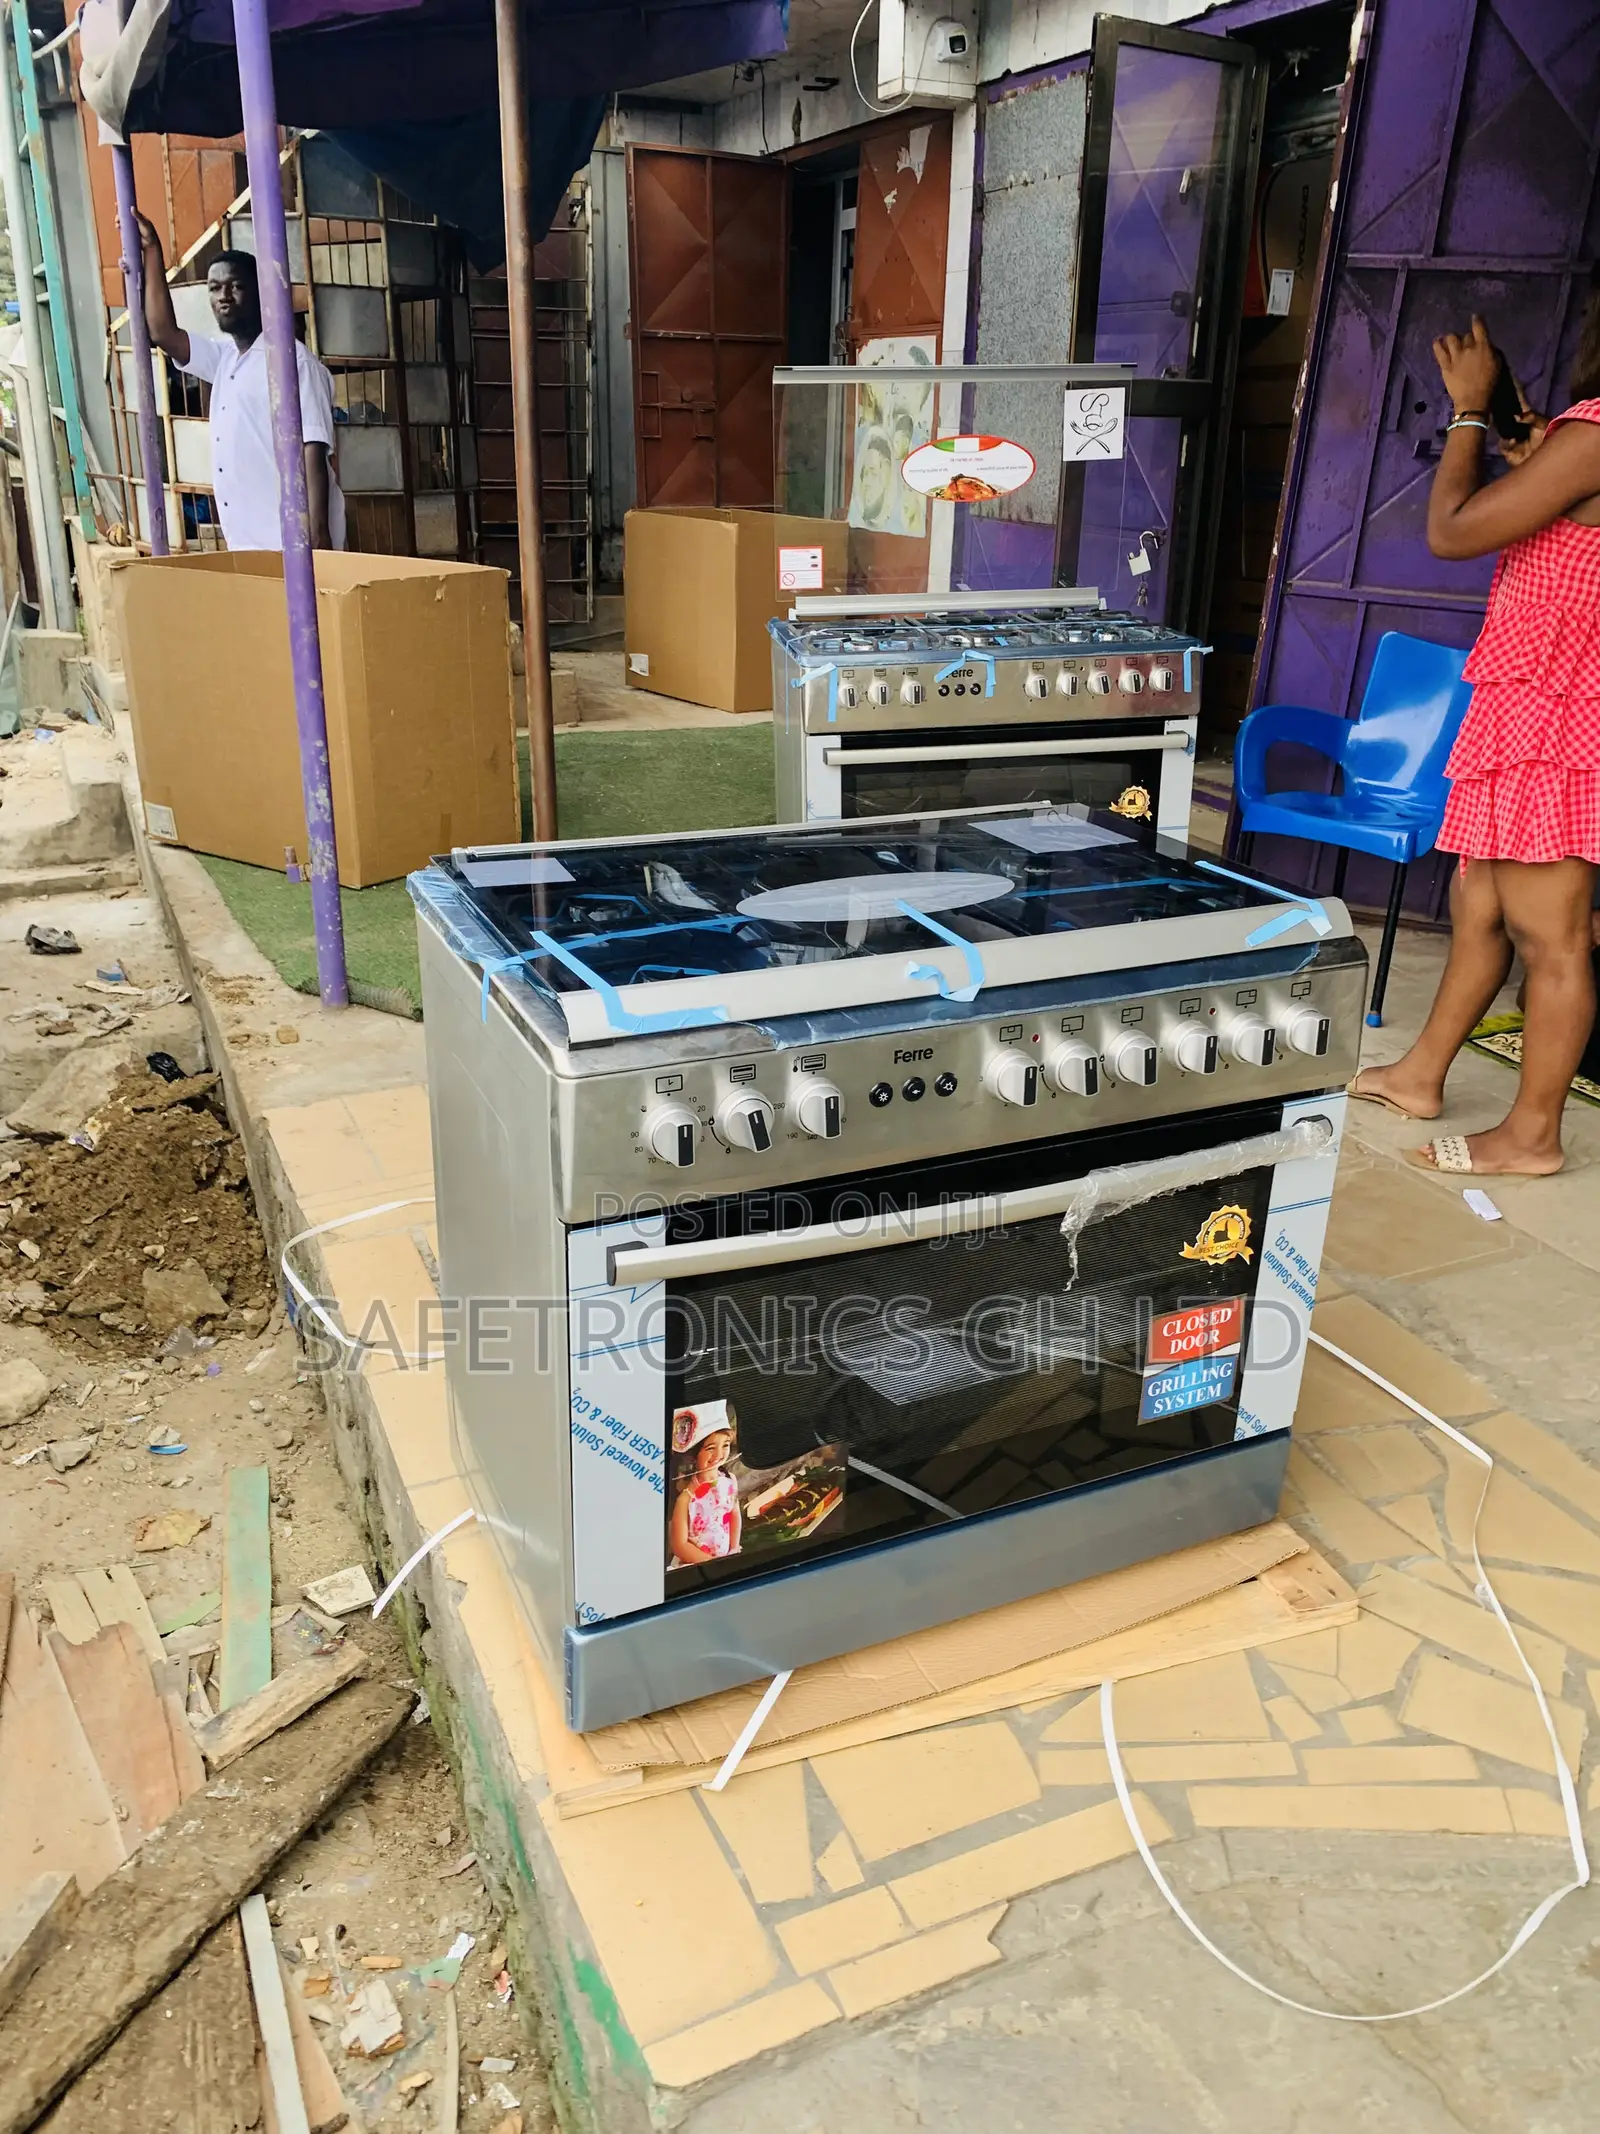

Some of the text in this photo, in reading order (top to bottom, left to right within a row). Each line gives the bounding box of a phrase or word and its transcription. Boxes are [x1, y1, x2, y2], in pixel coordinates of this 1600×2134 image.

[1297, 185, 1309, 267] VOLCANO
[946, 669, 974, 678] erre
[893, 1048, 934, 1064] Ferre
[697, 1105, 706, 1113] 20
[630, 1131, 640, 1139] 90
[786, 1132, 799, 1140] 190
[1198, 1246, 1214, 1254] BEST
[1215, 1242, 1239, 1252] CHOICE
[1285, 1246, 1296, 1258] &
[1263, 1250, 1292, 1285] Solution
[1292, 1253, 1312, 1277] Fiber
[1162, 1307, 1232, 1337] CLOSED
[1169, 1329, 1221, 1355] DOOR
[1147, 1362, 1233, 1397] GRILLING
[1153, 1382, 1222, 1414] SYSTEM
[588, 1406, 602, 1421] &
[571, 1421, 604, 1451] Solut
[600, 1415, 633, 1441] Fiber
[599, 1444, 650, 1480] Novacel
[628, 1433, 665, 1465] ASER
